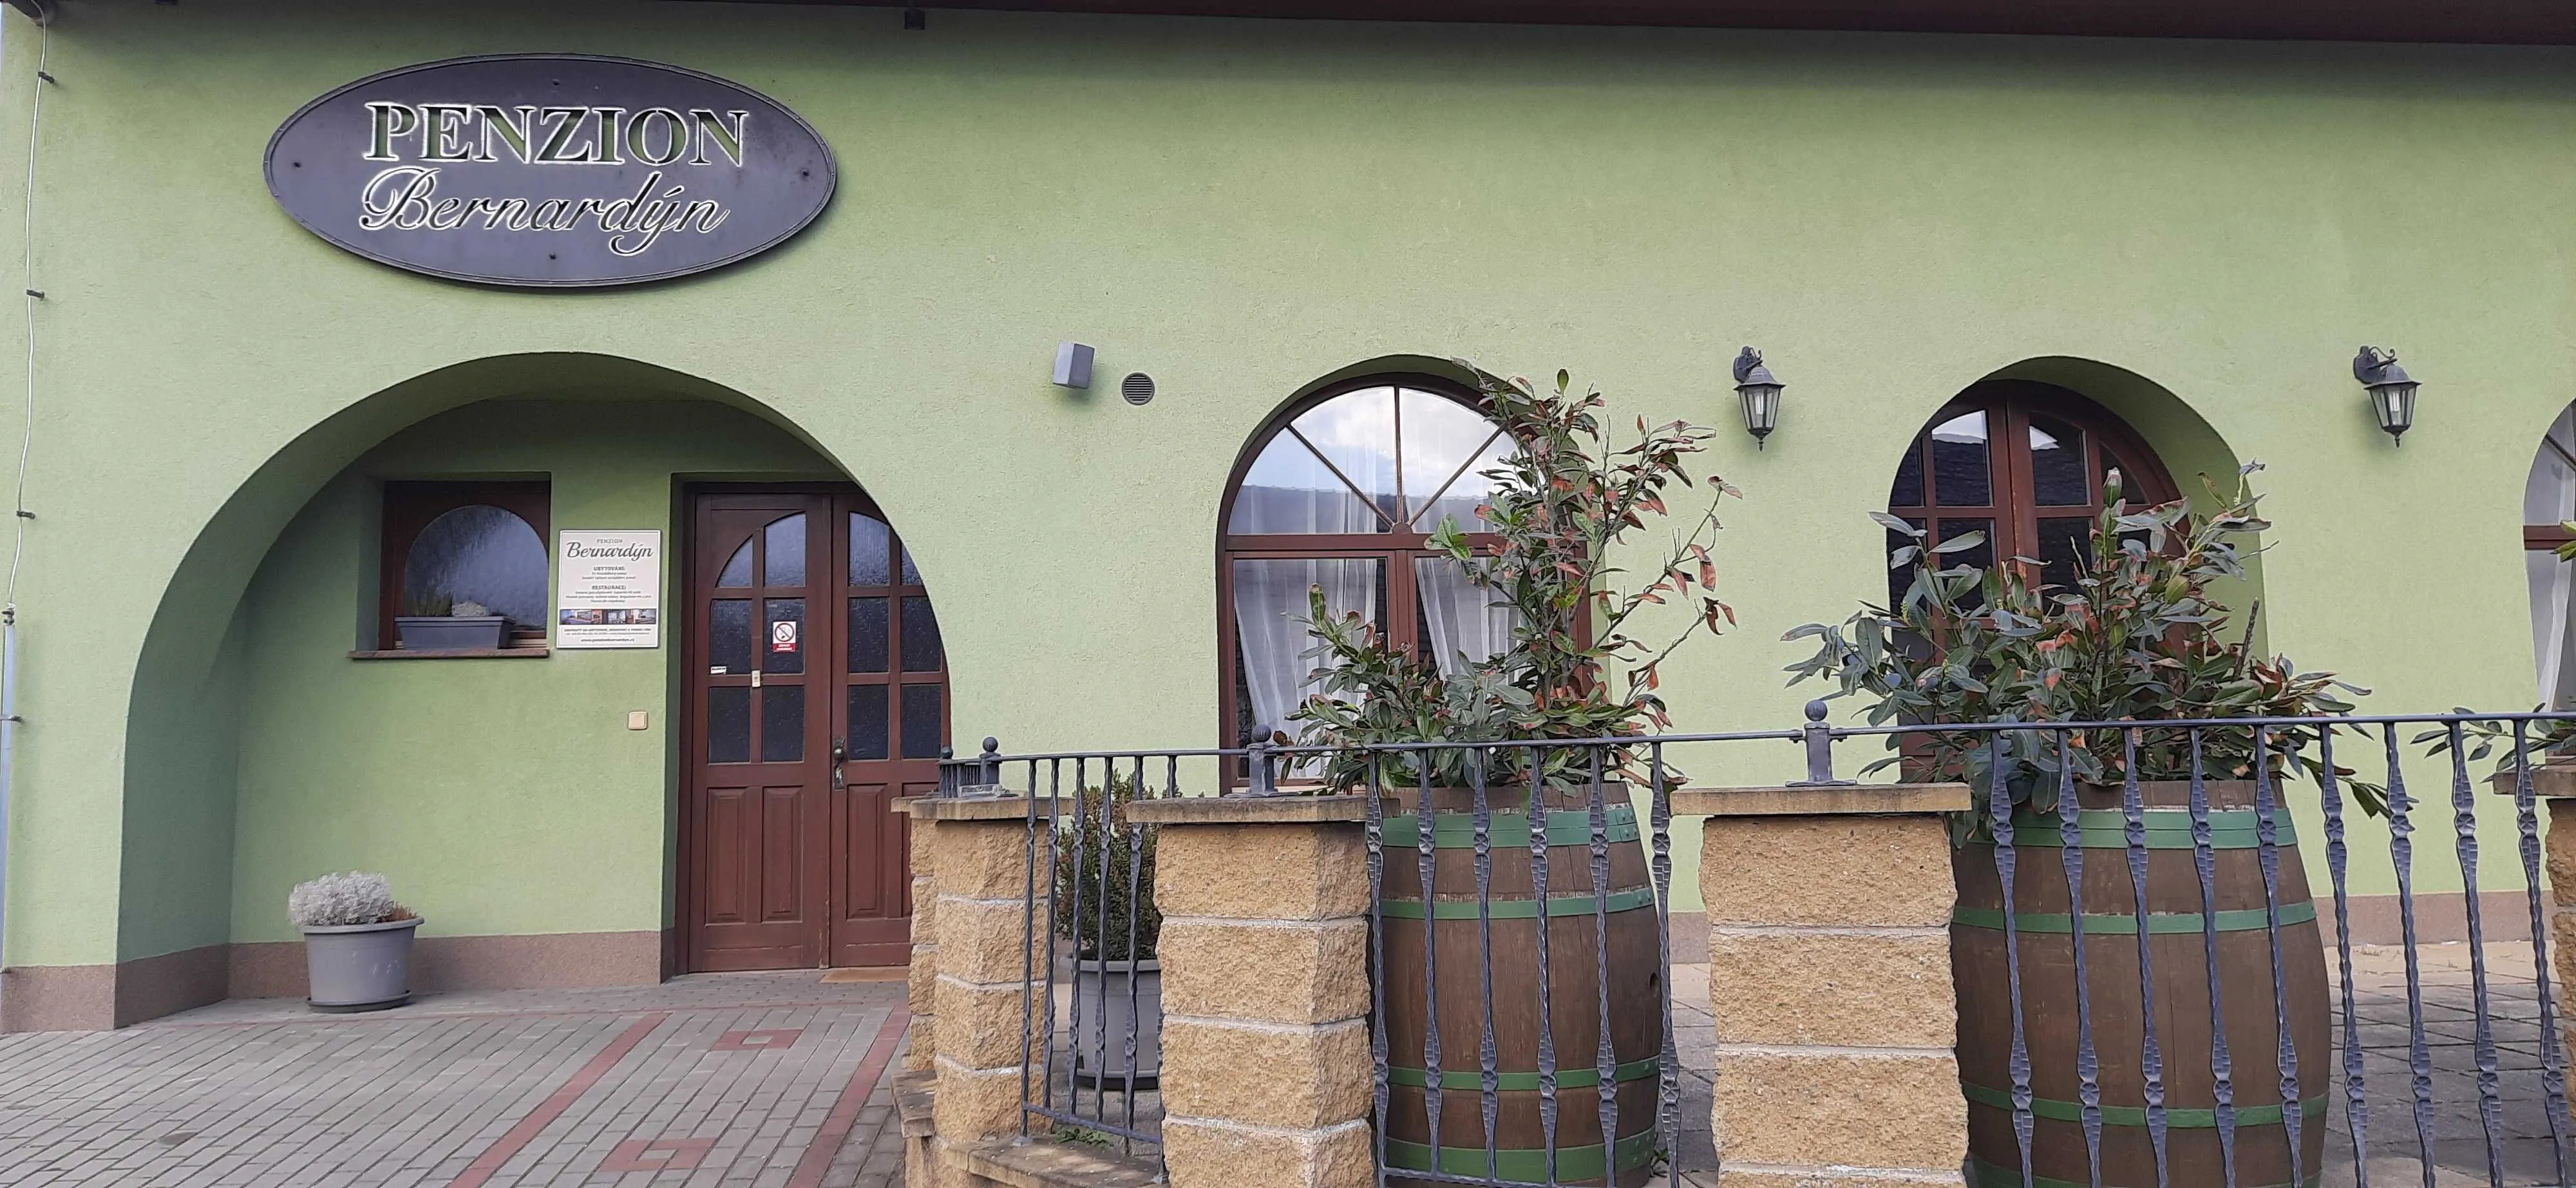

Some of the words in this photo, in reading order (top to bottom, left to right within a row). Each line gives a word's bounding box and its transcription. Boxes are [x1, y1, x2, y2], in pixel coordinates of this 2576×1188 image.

[363, 101, 749, 168] PENZION
[359, 166, 730, 257] Bernardýn
[566, 542, 654, 561] Bernardýn
